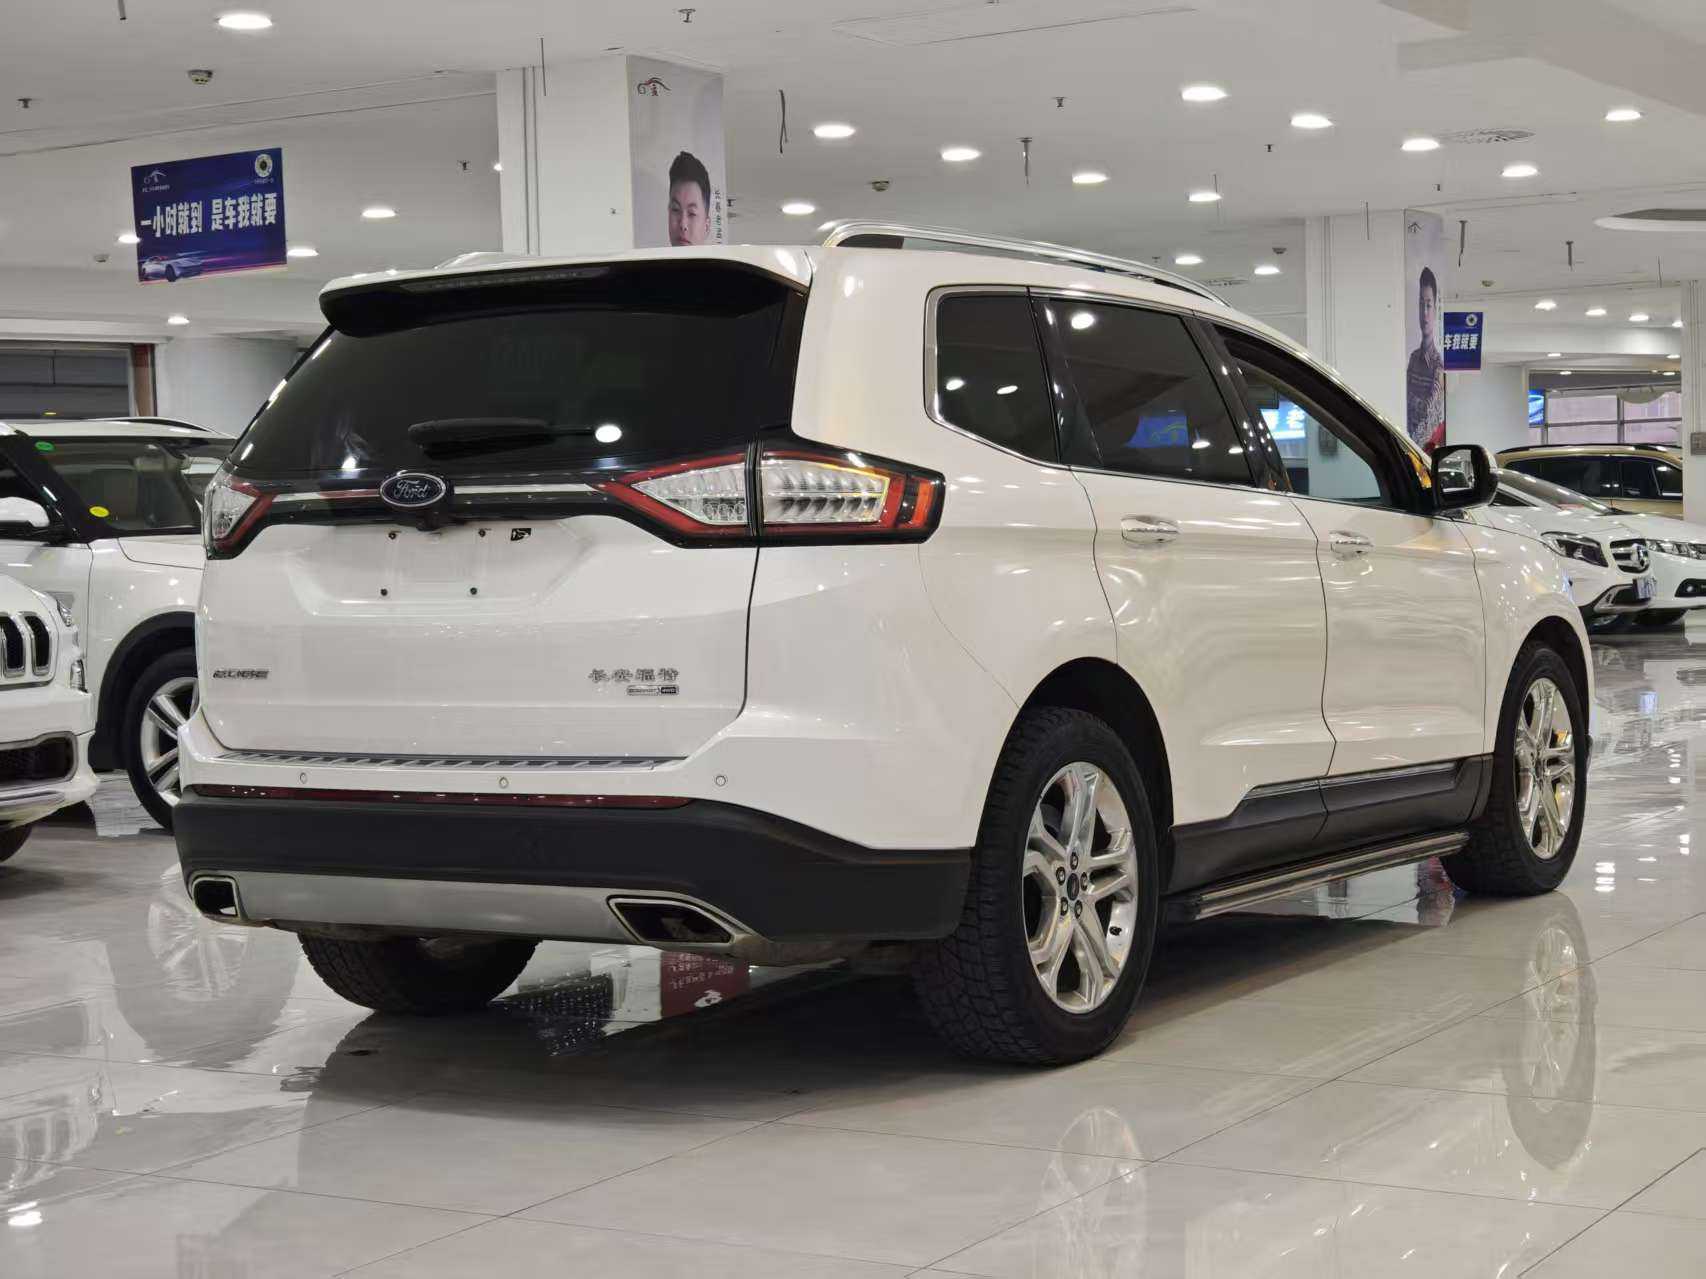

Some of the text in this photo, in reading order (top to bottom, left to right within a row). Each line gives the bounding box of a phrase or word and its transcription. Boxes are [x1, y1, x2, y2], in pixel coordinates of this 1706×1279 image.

[141, 193, 277, 238] 一小时就到 是车我就要
[394, 480, 429, 498] Ford
